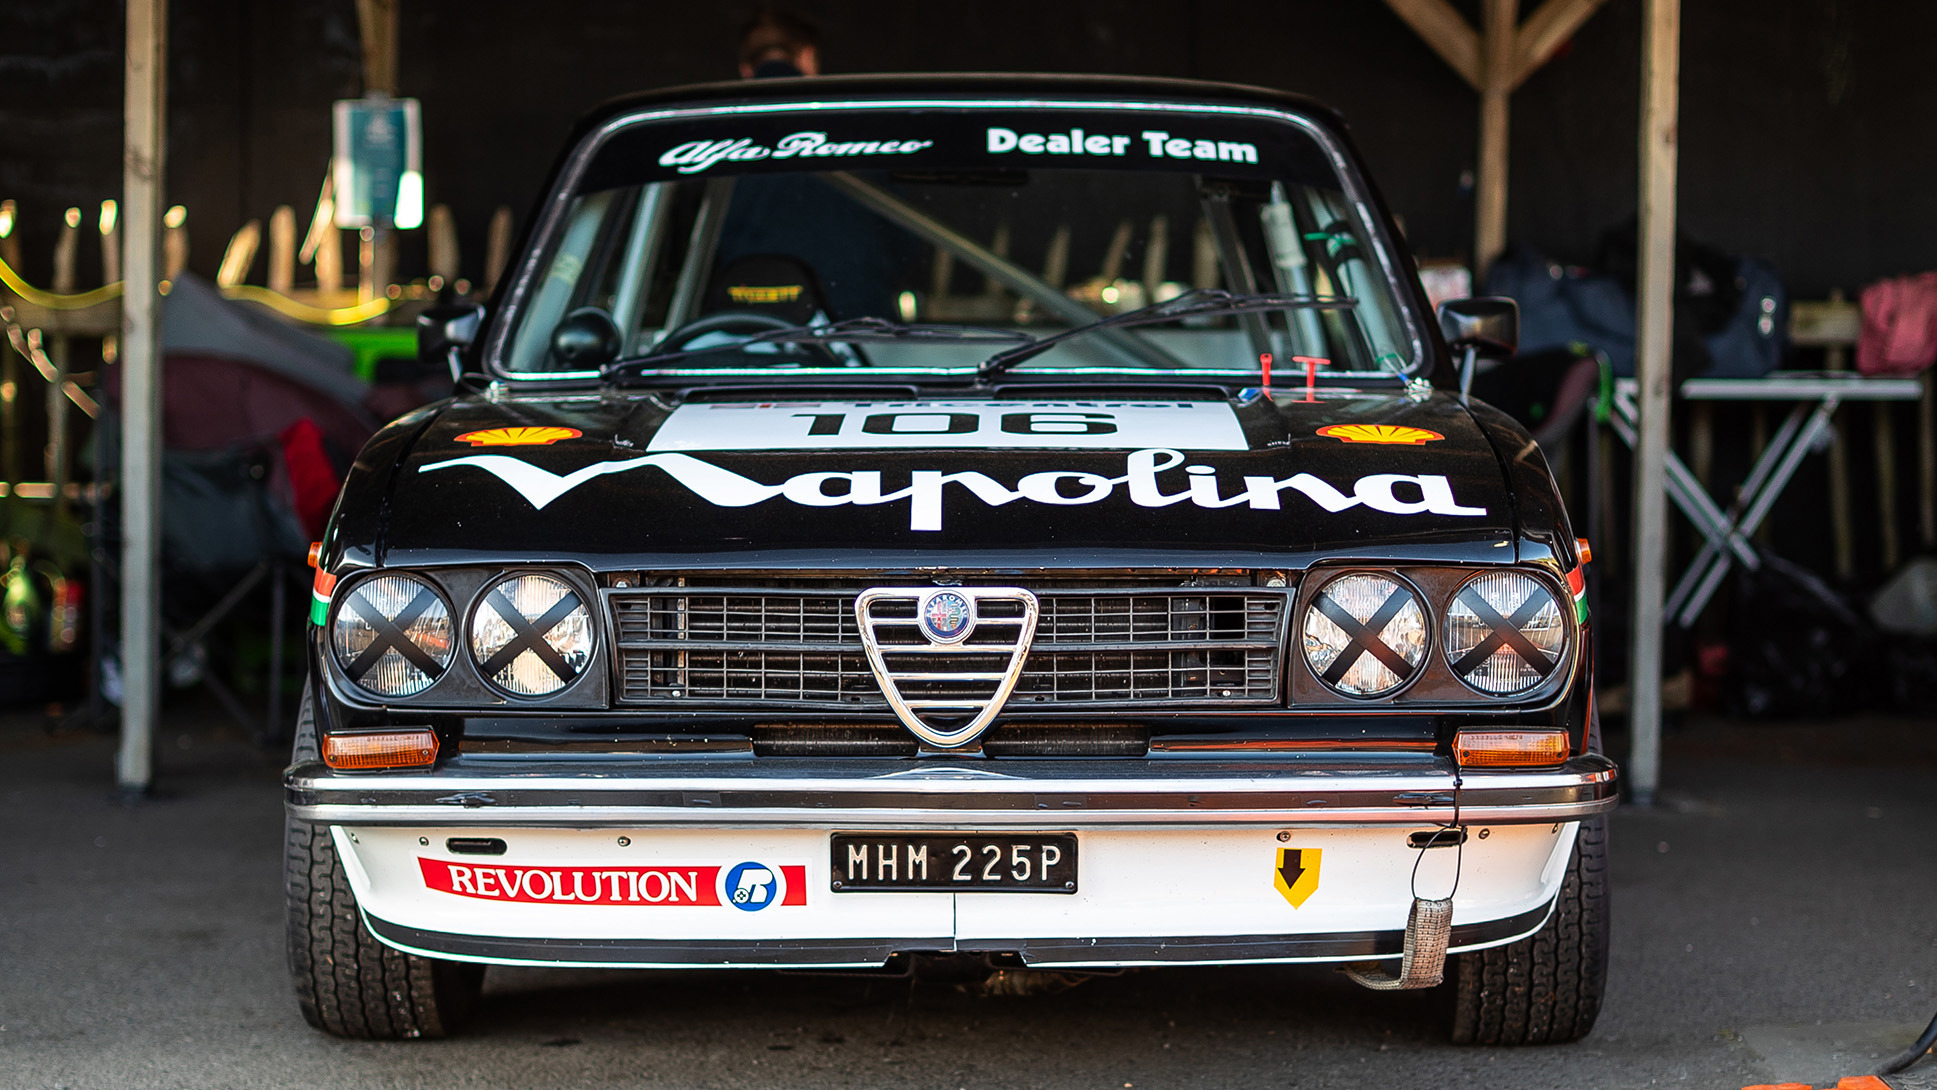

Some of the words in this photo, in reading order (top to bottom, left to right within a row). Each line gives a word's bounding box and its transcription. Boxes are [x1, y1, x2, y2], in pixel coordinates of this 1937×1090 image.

[658, 138, 771, 173] Alfa
[771, 131, 932, 158] Romeo
[987, 127, 1131, 155] Dealer
[1141, 130, 1258, 162] Team
[793, 413, 1118, 435] 106
[419, 447, 1487, 531] Napolina
[847, 844, 928, 881] MHM
[951, 842, 1061, 881] 225P
[447, 865, 698, 902] REVOLUTION
